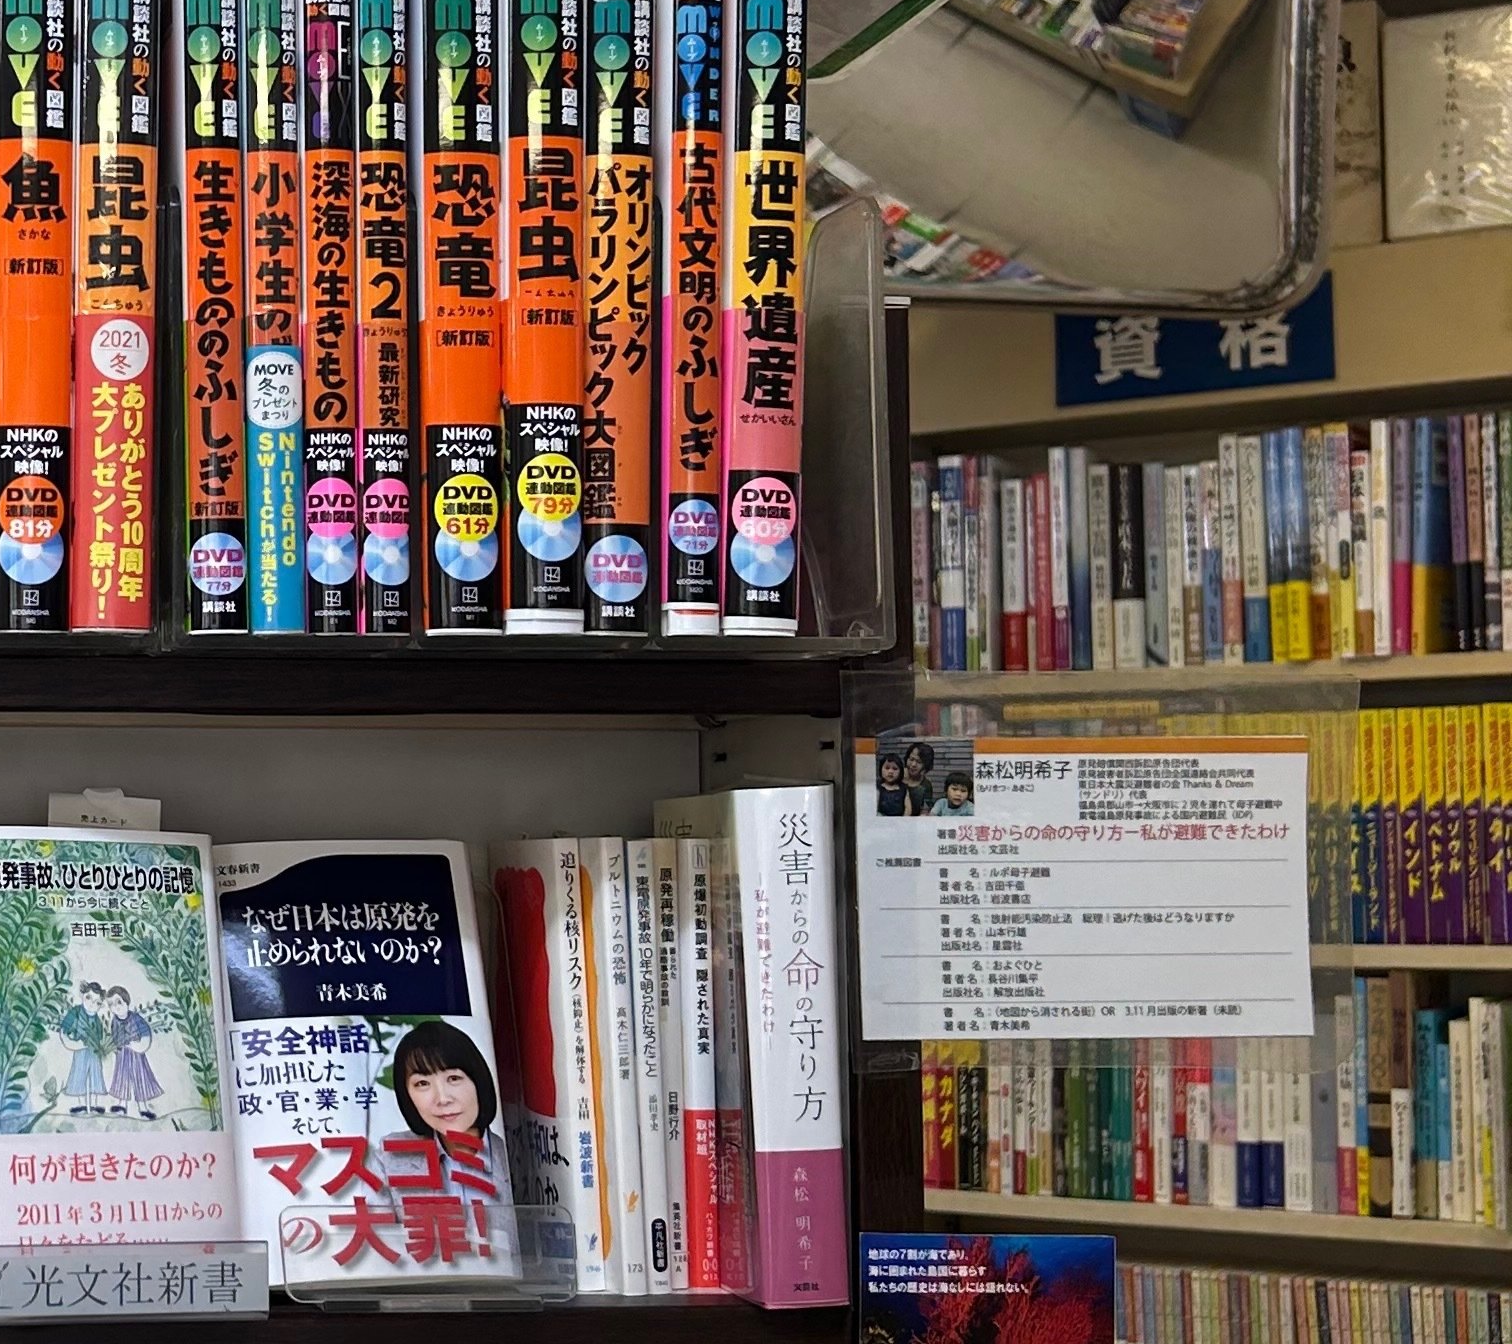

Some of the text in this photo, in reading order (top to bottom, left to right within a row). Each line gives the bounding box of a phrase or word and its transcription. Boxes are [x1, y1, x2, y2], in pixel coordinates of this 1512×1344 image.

[2, 154, 66, 223] 魚
[85, 155, 151, 292] 昆虫
[360, 161, 406, 320] 恐竜2
[434, 162, 496, 299] 恐竜
[518, 147, 579, 285] 昆虫
[192, 160, 240, 497] 生きもののふしぎ
[311, 160, 351, 423] 深海の生きもの
[677, 142, 718, 471] 古代文明のふしぎ
[743, 161, 799, 411] 世界遺産
[99, 329, 142, 349] 2021
[120, 383, 147, 603] ありがとう10周年
[975, 760, 1072, 782] 森松明希子
[71, 922, 124, 939] 吉田千亜
[242, 901, 440, 935] なぜ日本は原発を
[246, 935, 443, 970] 止められないのか?
[559, 852, 583, 990] 迫りくる核リスク
[777, 811, 827, 1124] 災害からの命の守り方
[316, 982, 388, 1003] 青木美希
[9, 1152, 218, 1186] 何が起きたのか?
[252, 1129, 499, 1199] マスコミ
[21, 1261, 244, 1307] 光文社新書
[282, 1195, 492, 1268] の大罪!
